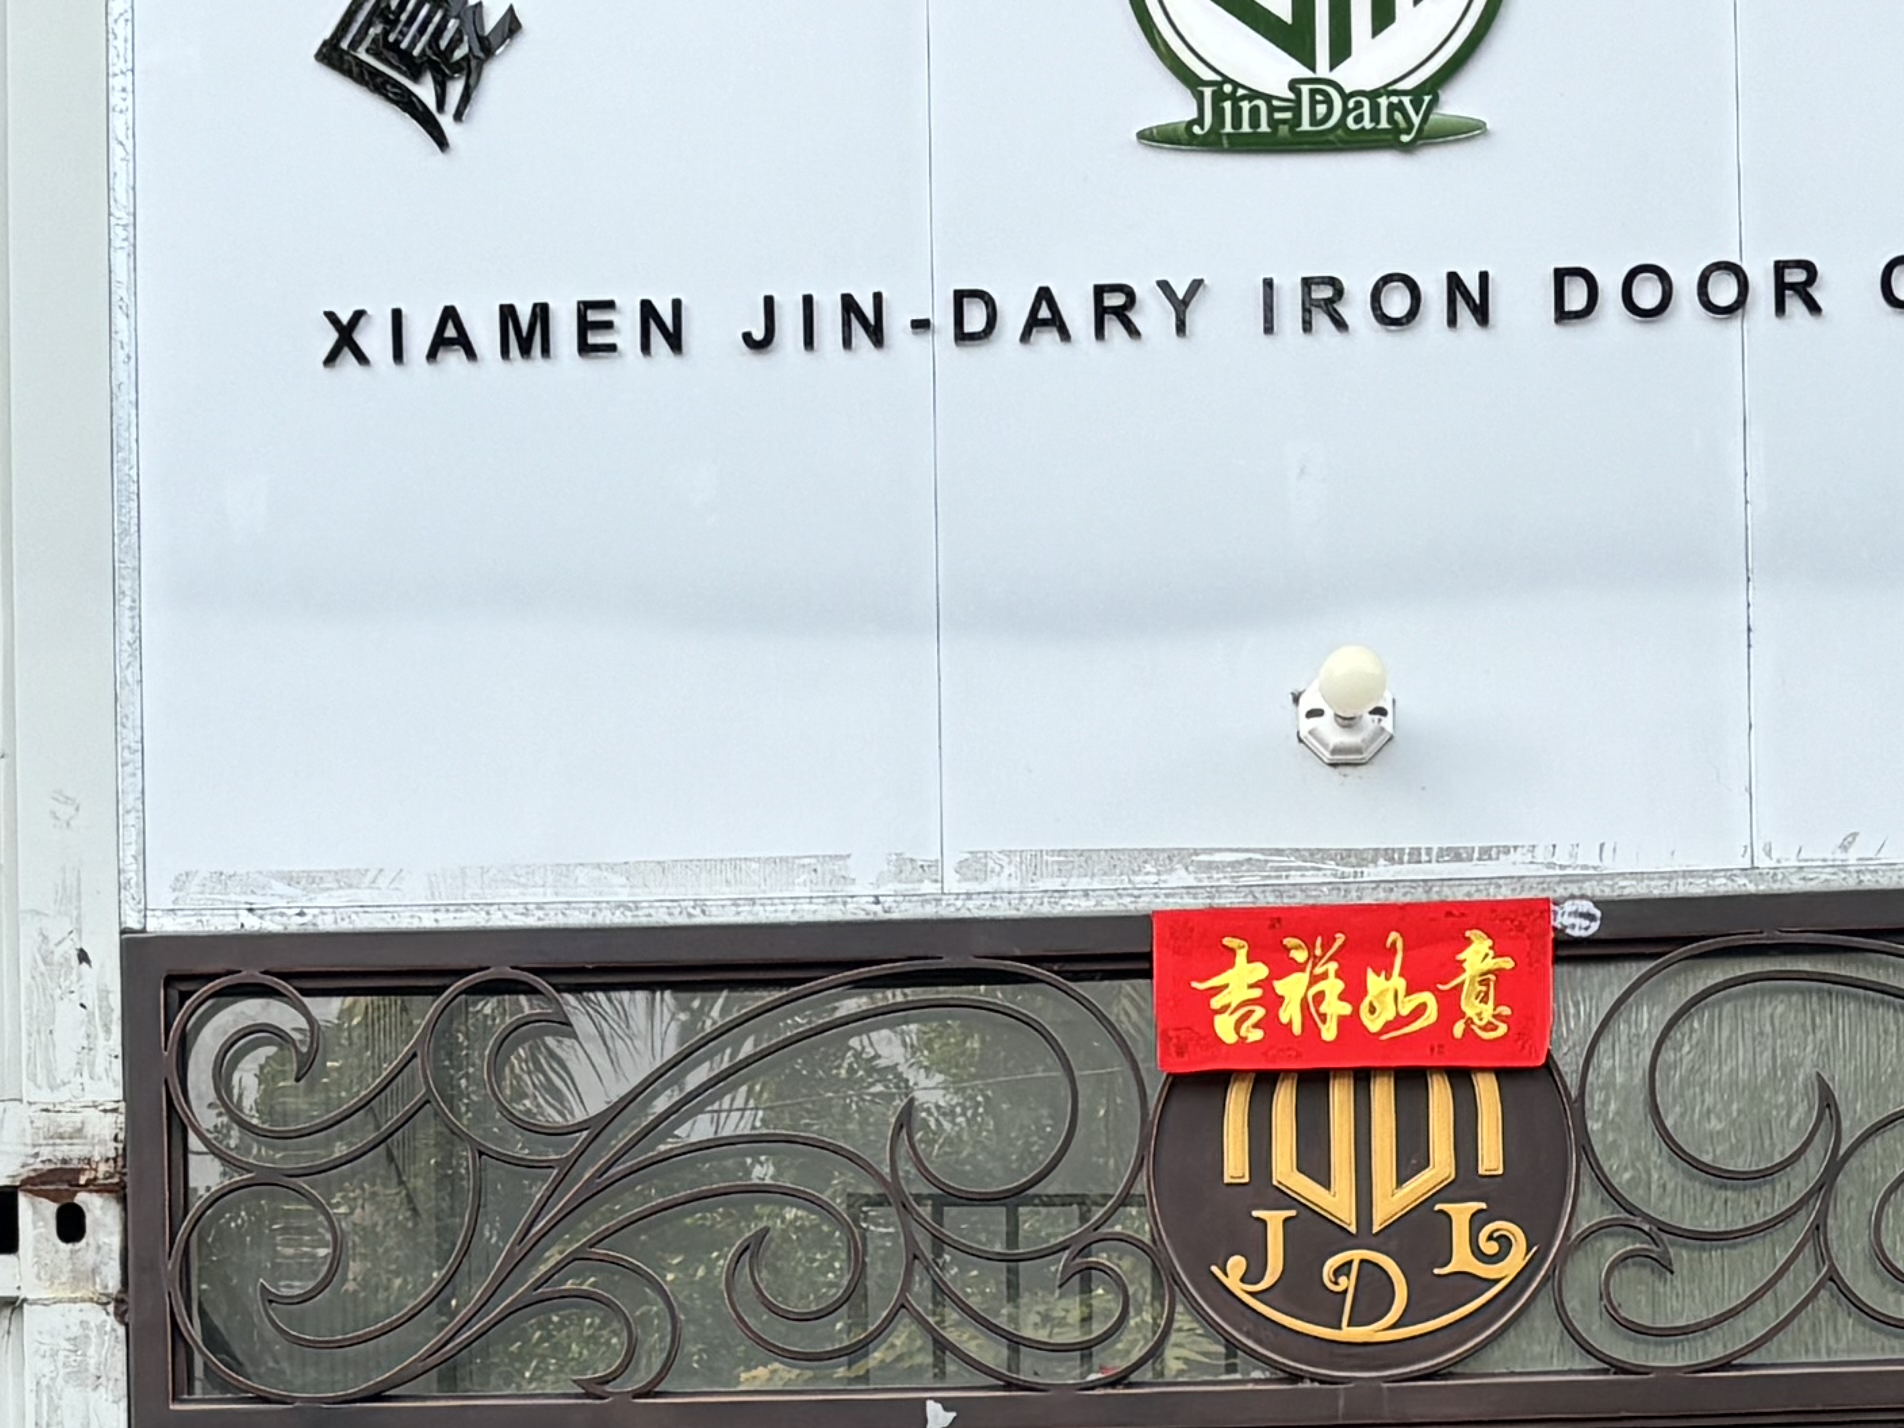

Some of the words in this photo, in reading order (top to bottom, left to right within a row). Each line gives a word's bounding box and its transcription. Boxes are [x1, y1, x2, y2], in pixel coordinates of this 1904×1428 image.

[1193, 83, 1433, 143] Jin-Dary
[323, 297, 685, 368] XIAMEN
[741, 277, 1206, 351] JIN-DARY
[1261, 270, 1490, 335] IRON
[1552, 258, 1823, 324] DOOR
[1191, 929, 1515, 1044] 吉祥如意
